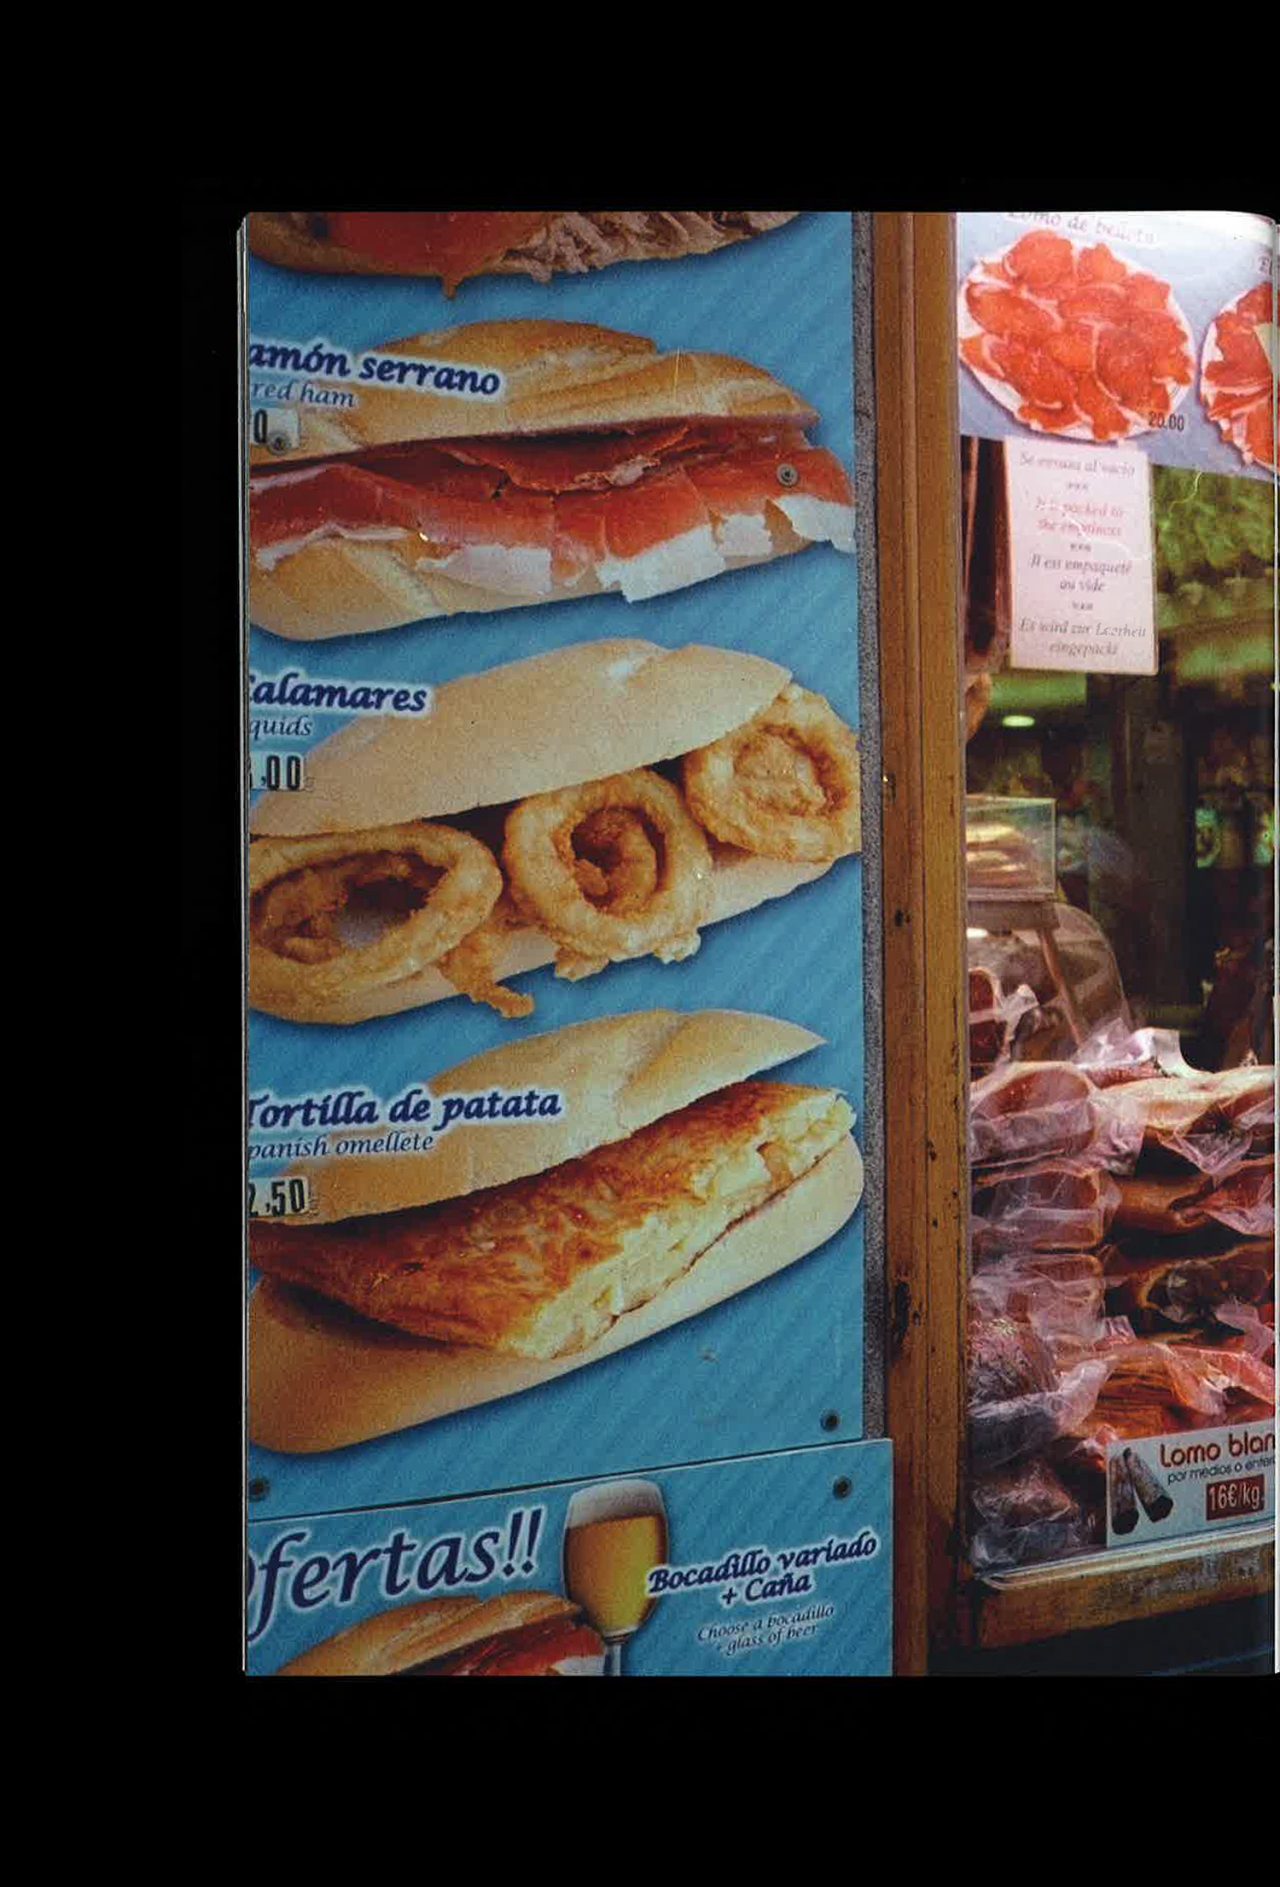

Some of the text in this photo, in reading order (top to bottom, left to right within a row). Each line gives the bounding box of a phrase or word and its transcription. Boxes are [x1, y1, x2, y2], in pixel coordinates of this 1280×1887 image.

[358, 356, 500, 395] serrano
[299, 380, 356, 407] ham
[388, 1088, 432, 1124] de
[433, 1089, 563, 1132] patata
[336, 1130, 434, 1156] omellete
[1159, 1442, 1222, 1468] Lomo
[1167, 1468, 1187, 1486] por
[1190, 1461, 1233, 1480] medios
[1235, 1463, 1243, 1473] o
[248, 1508, 545, 1643] fertas!!
[648, 1531, 878, 1594] Bocadillo variado
[721, 1572, 813, 1605] + Caña
[697, 1604, 835, 1642] Choose a bocadillo
[727, 1634, 764, 1657] glass
[768, 1628, 783, 1648] of
[786, 1623, 819, 1641] beer
